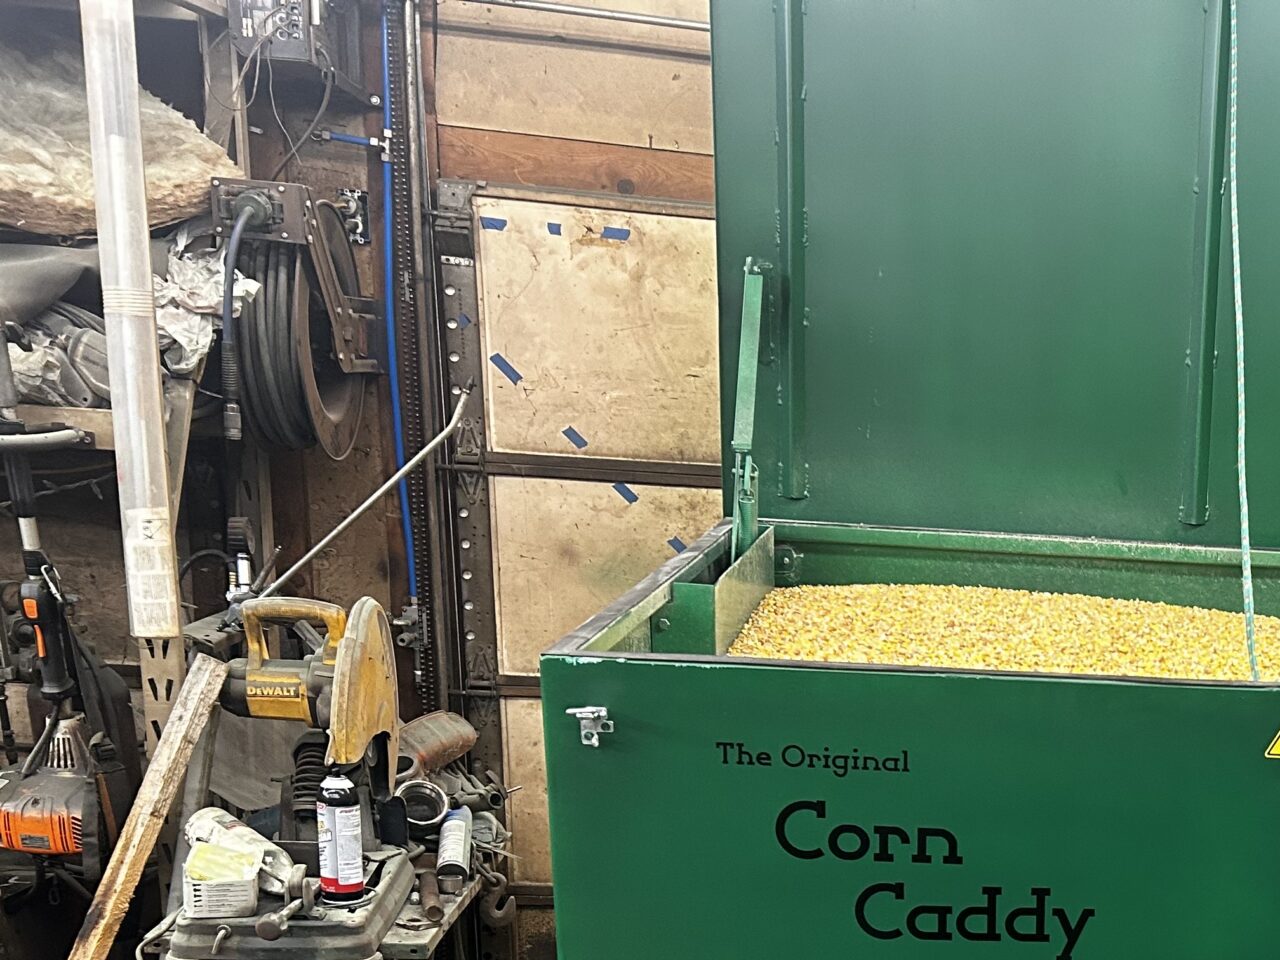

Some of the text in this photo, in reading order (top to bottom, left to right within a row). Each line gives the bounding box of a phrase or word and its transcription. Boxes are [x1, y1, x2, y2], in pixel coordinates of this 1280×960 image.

[247, 686, 297, 697] DEWALT
[716, 742, 910, 778] The Original
[775, 800, 963, 865] Corn
